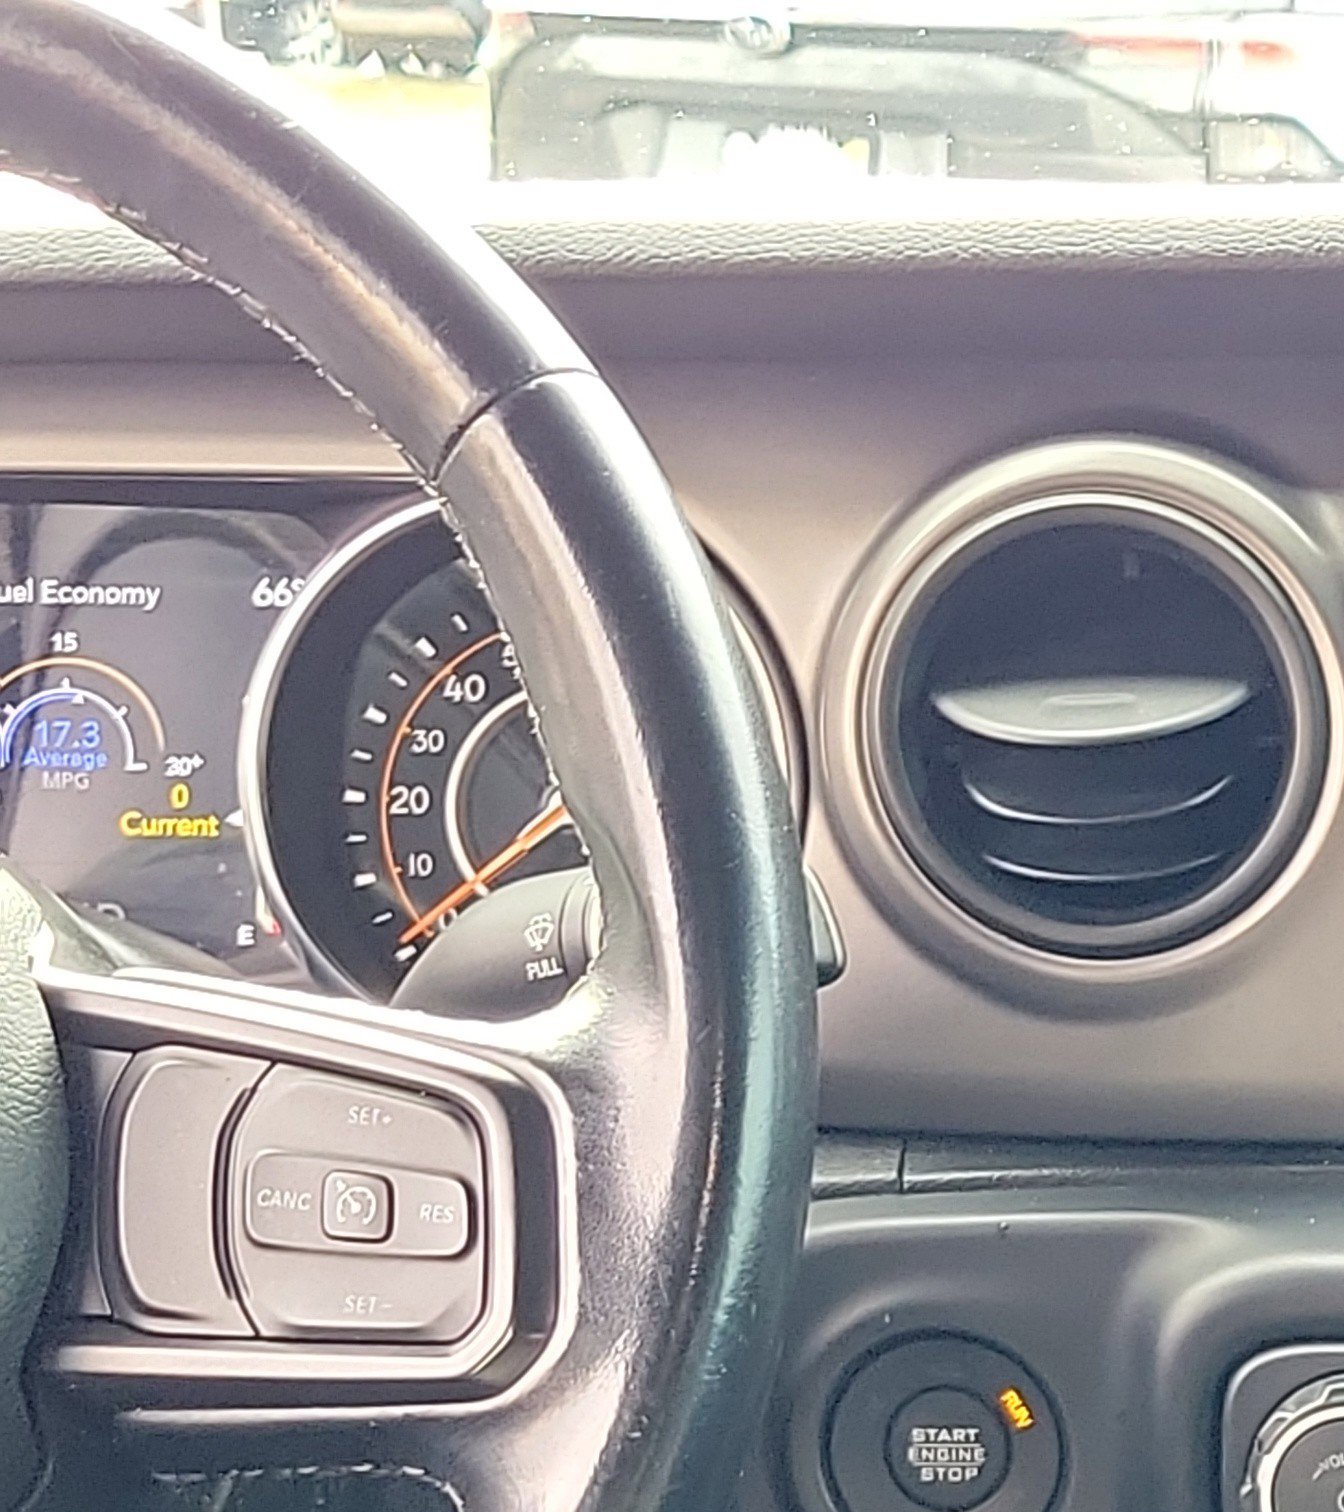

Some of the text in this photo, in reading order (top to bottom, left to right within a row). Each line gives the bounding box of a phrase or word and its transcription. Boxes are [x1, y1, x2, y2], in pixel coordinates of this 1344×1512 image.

[40, 579, 162, 611] Economy
[50, 631, 78, 652] 15
[442, 673, 486, 703] 40
[34, 720, 101, 748] 17.3
[411, 729, 444, 753] 30
[23, 752, 107, 769] Average
[42, 772, 90, 790] MPG
[170, 783, 190, 809] 0
[390, 785, 430, 814] 20
[119, 810, 220, 837] Current
[407, 852, 433, 876] 10
[237, 925, 254, 946] E
[525, 957, 564, 981] PULL
[257, 1189, 311, 1211] CANC
[419, 1203, 454, 1223] RES
[1000, 1389, 1034, 1429] RUN
[911, 1428, 979, 1443] START
[908, 1447, 986, 1462] ENGINE
[920, 1467, 978, 1482] STOP
